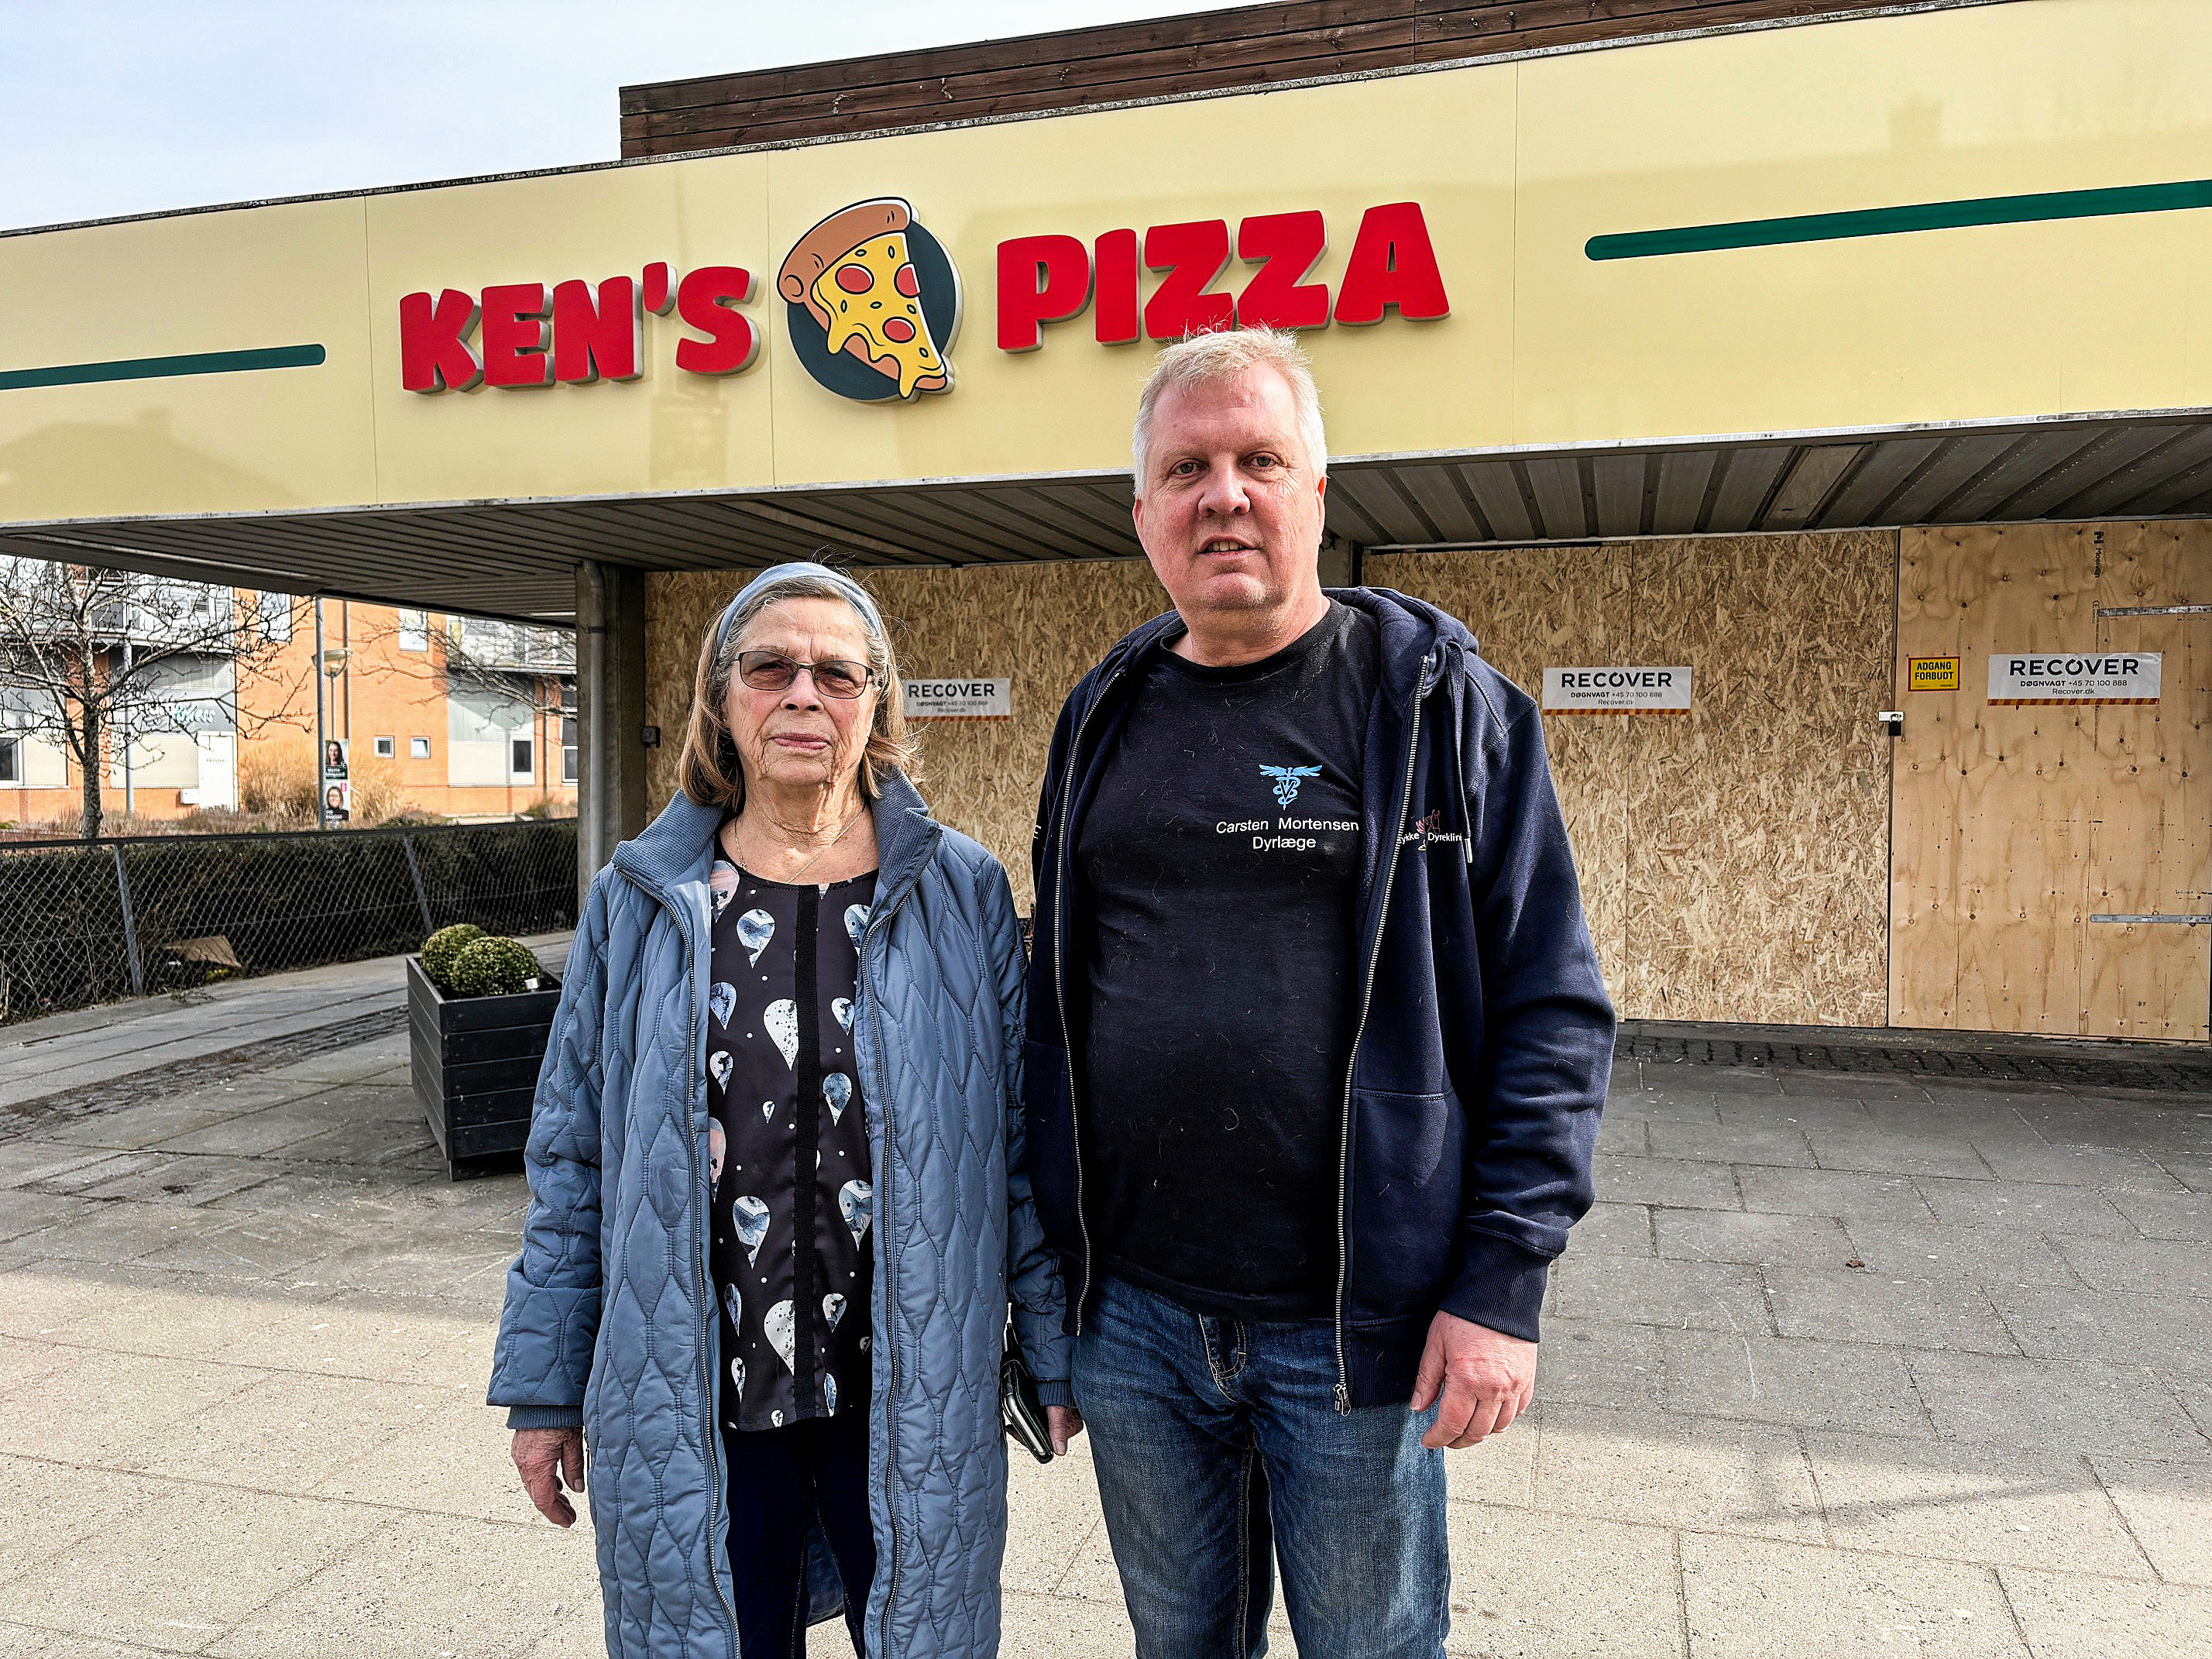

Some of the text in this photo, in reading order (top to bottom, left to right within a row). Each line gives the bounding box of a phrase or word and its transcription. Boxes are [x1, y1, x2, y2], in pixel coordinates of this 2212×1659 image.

[400, 201, 1451, 393] KEN'S PIZZA
[1917, 661, 1952, 670] ADGANG
[2009, 658, 2139, 676] RECOVER
[1561, 672, 1672, 688] RECOVER
[1915, 672, 1954, 680] FORBUDT
[908, 683, 995, 698] RECOVER
[1216, 817, 1359, 834] Carsten Mortensen
[1252, 835, 1317, 852] Dyrlæge
[1400, 832, 1420, 845] ykke
